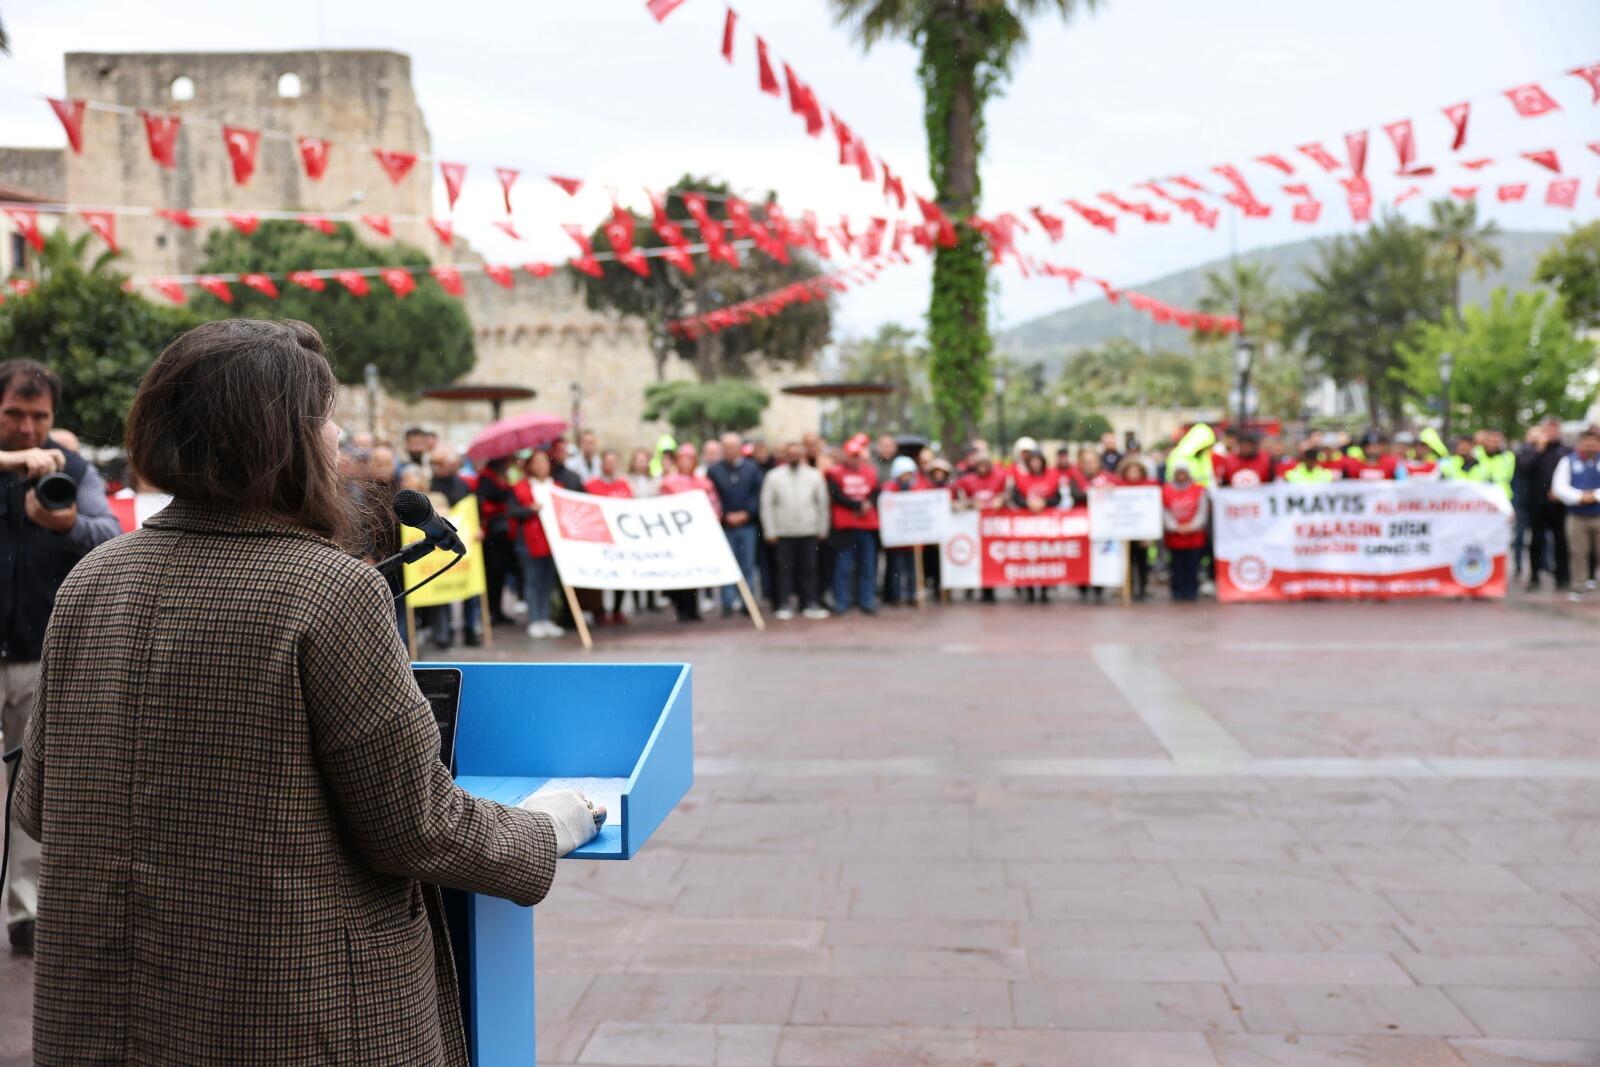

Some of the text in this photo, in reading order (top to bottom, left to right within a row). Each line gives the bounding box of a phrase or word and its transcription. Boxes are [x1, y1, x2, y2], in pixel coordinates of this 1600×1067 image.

[1268, 496, 1278, 516] 1
[616, 509, 693, 540] CHP
[989, 540, 1081, 561] ÇEŞME
